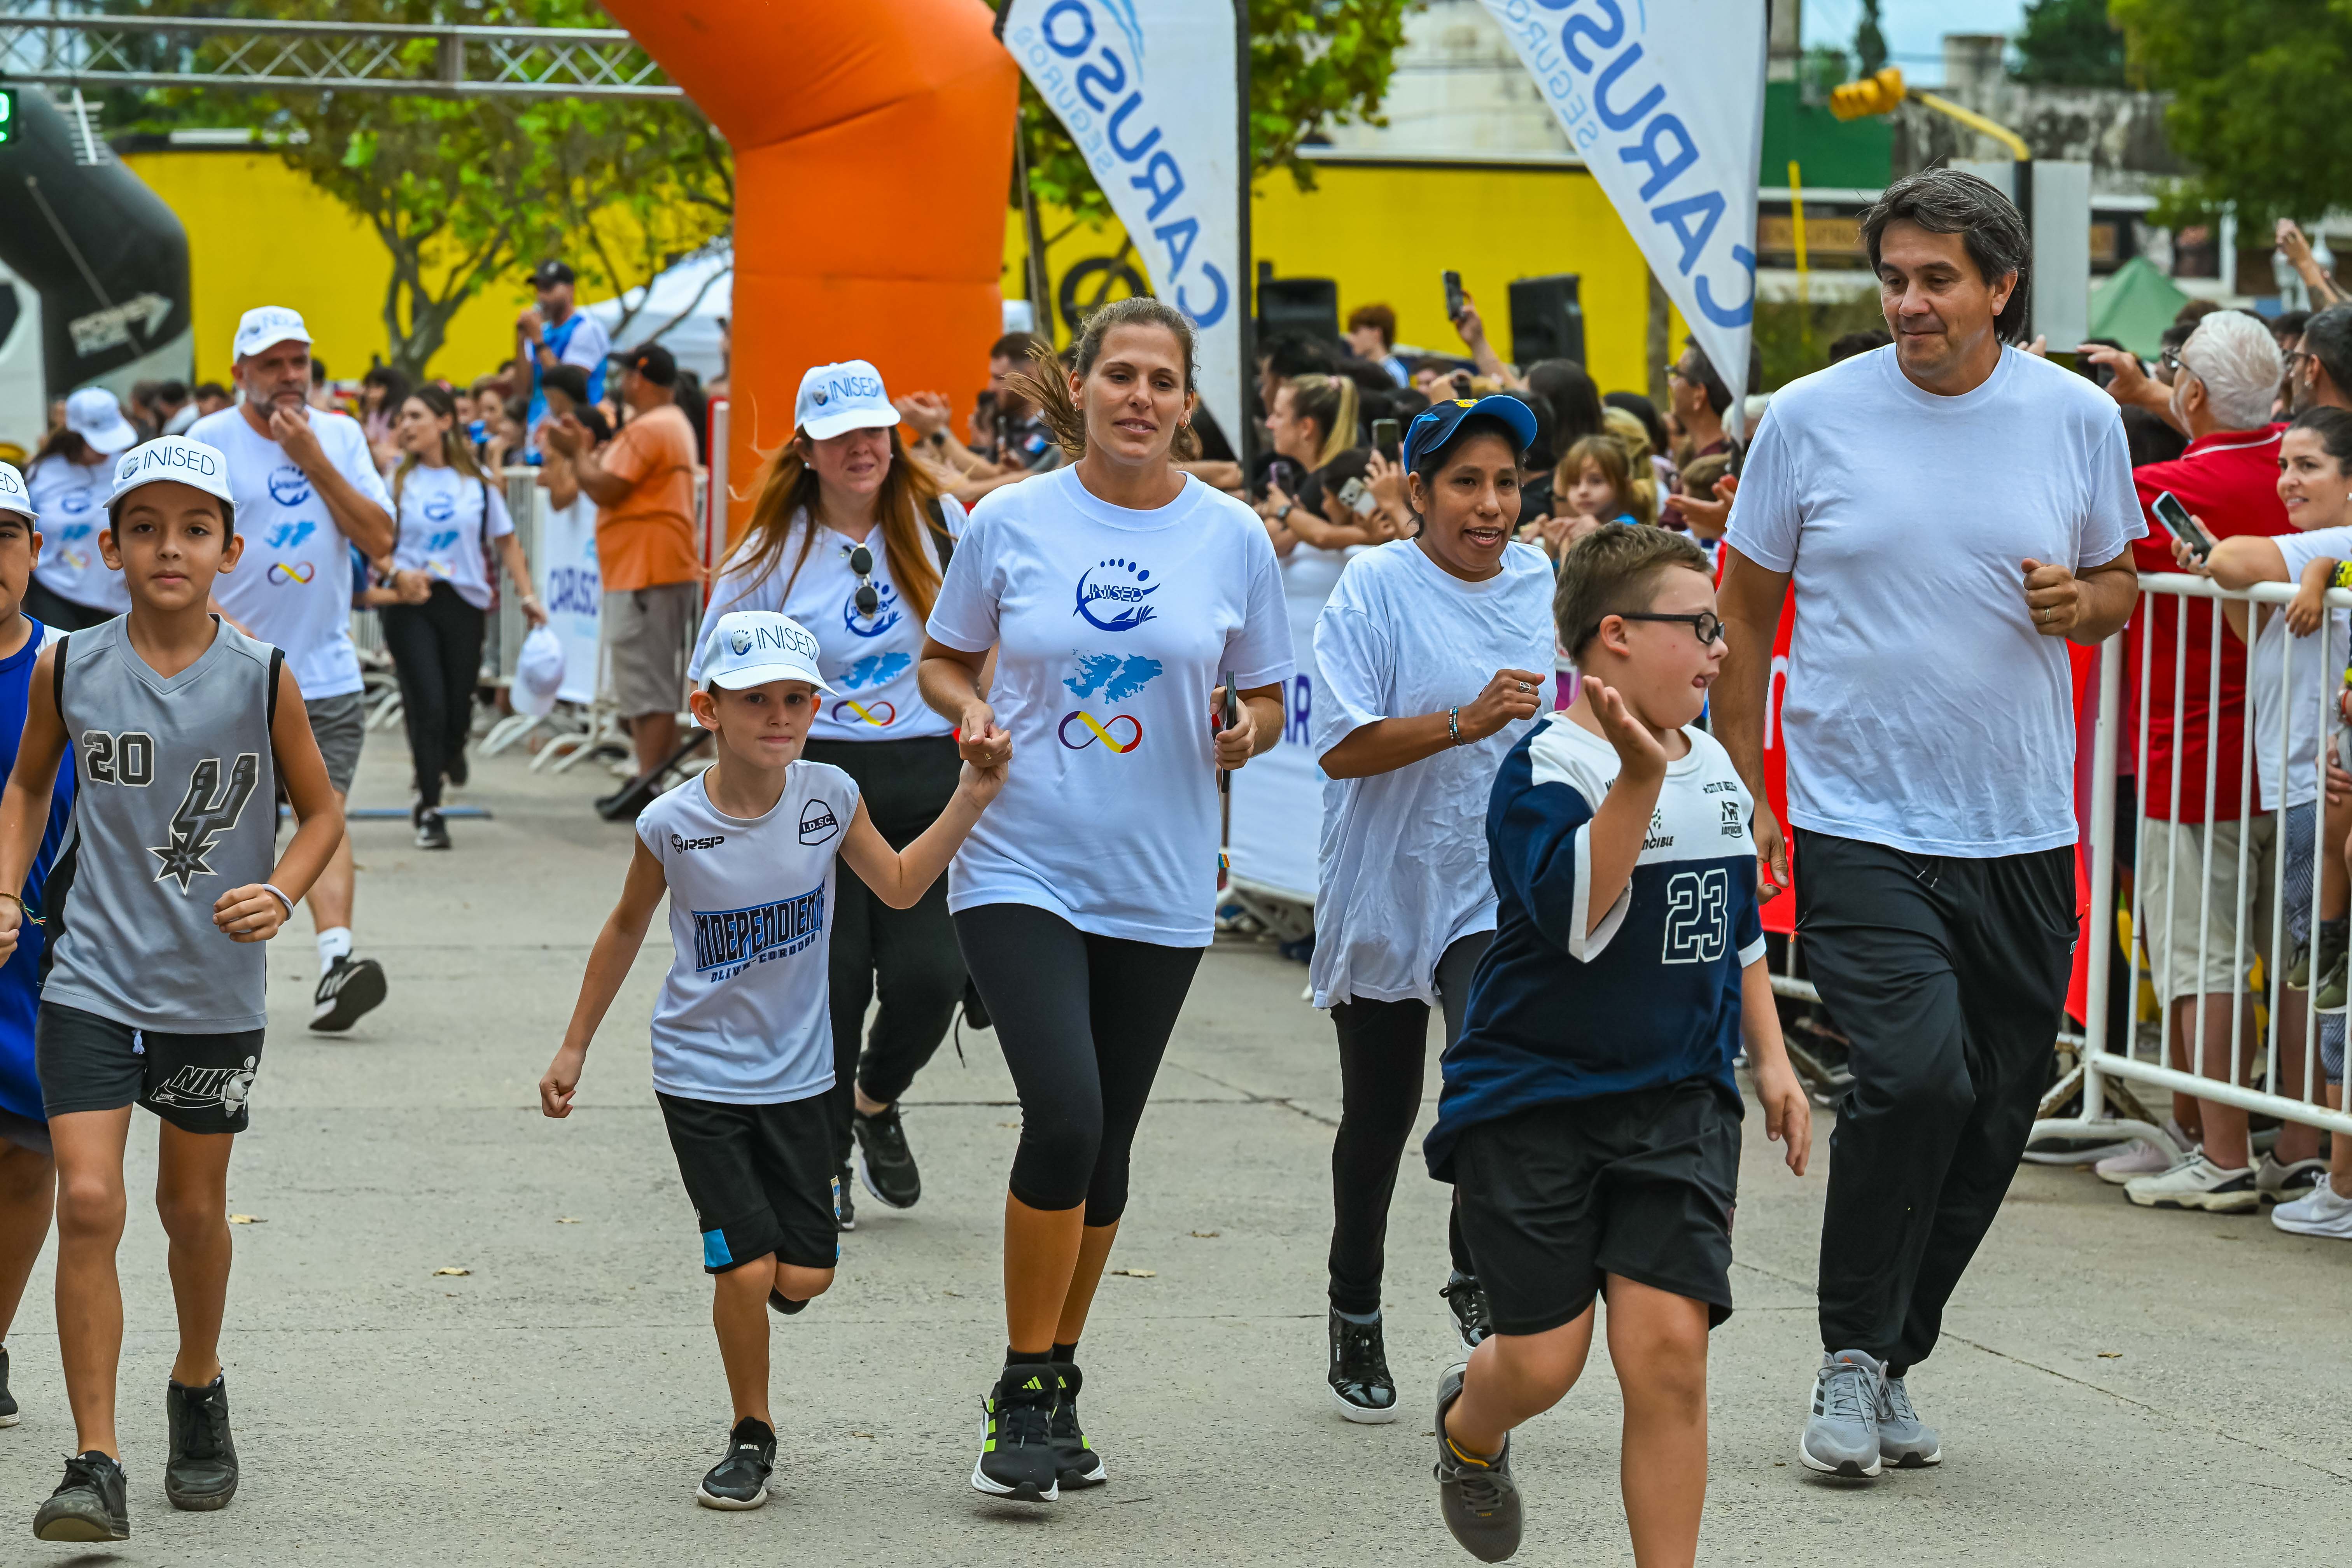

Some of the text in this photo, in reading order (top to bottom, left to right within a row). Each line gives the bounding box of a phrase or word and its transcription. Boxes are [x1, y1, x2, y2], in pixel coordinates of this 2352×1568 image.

[829, 377, 879, 400] INISED
[144, 446, 215, 475] INISED
[1089, 583, 1143, 602] INISED
[756, 625, 816, 661] INISED
[82, 730, 154, 787] 20
[684, 836, 725, 851] RSP
[1642, 836, 1674, 850] NCIBLE
[691, 878, 825, 970] INDEPENDIENTE
[1662, 868, 1728, 964] 23
